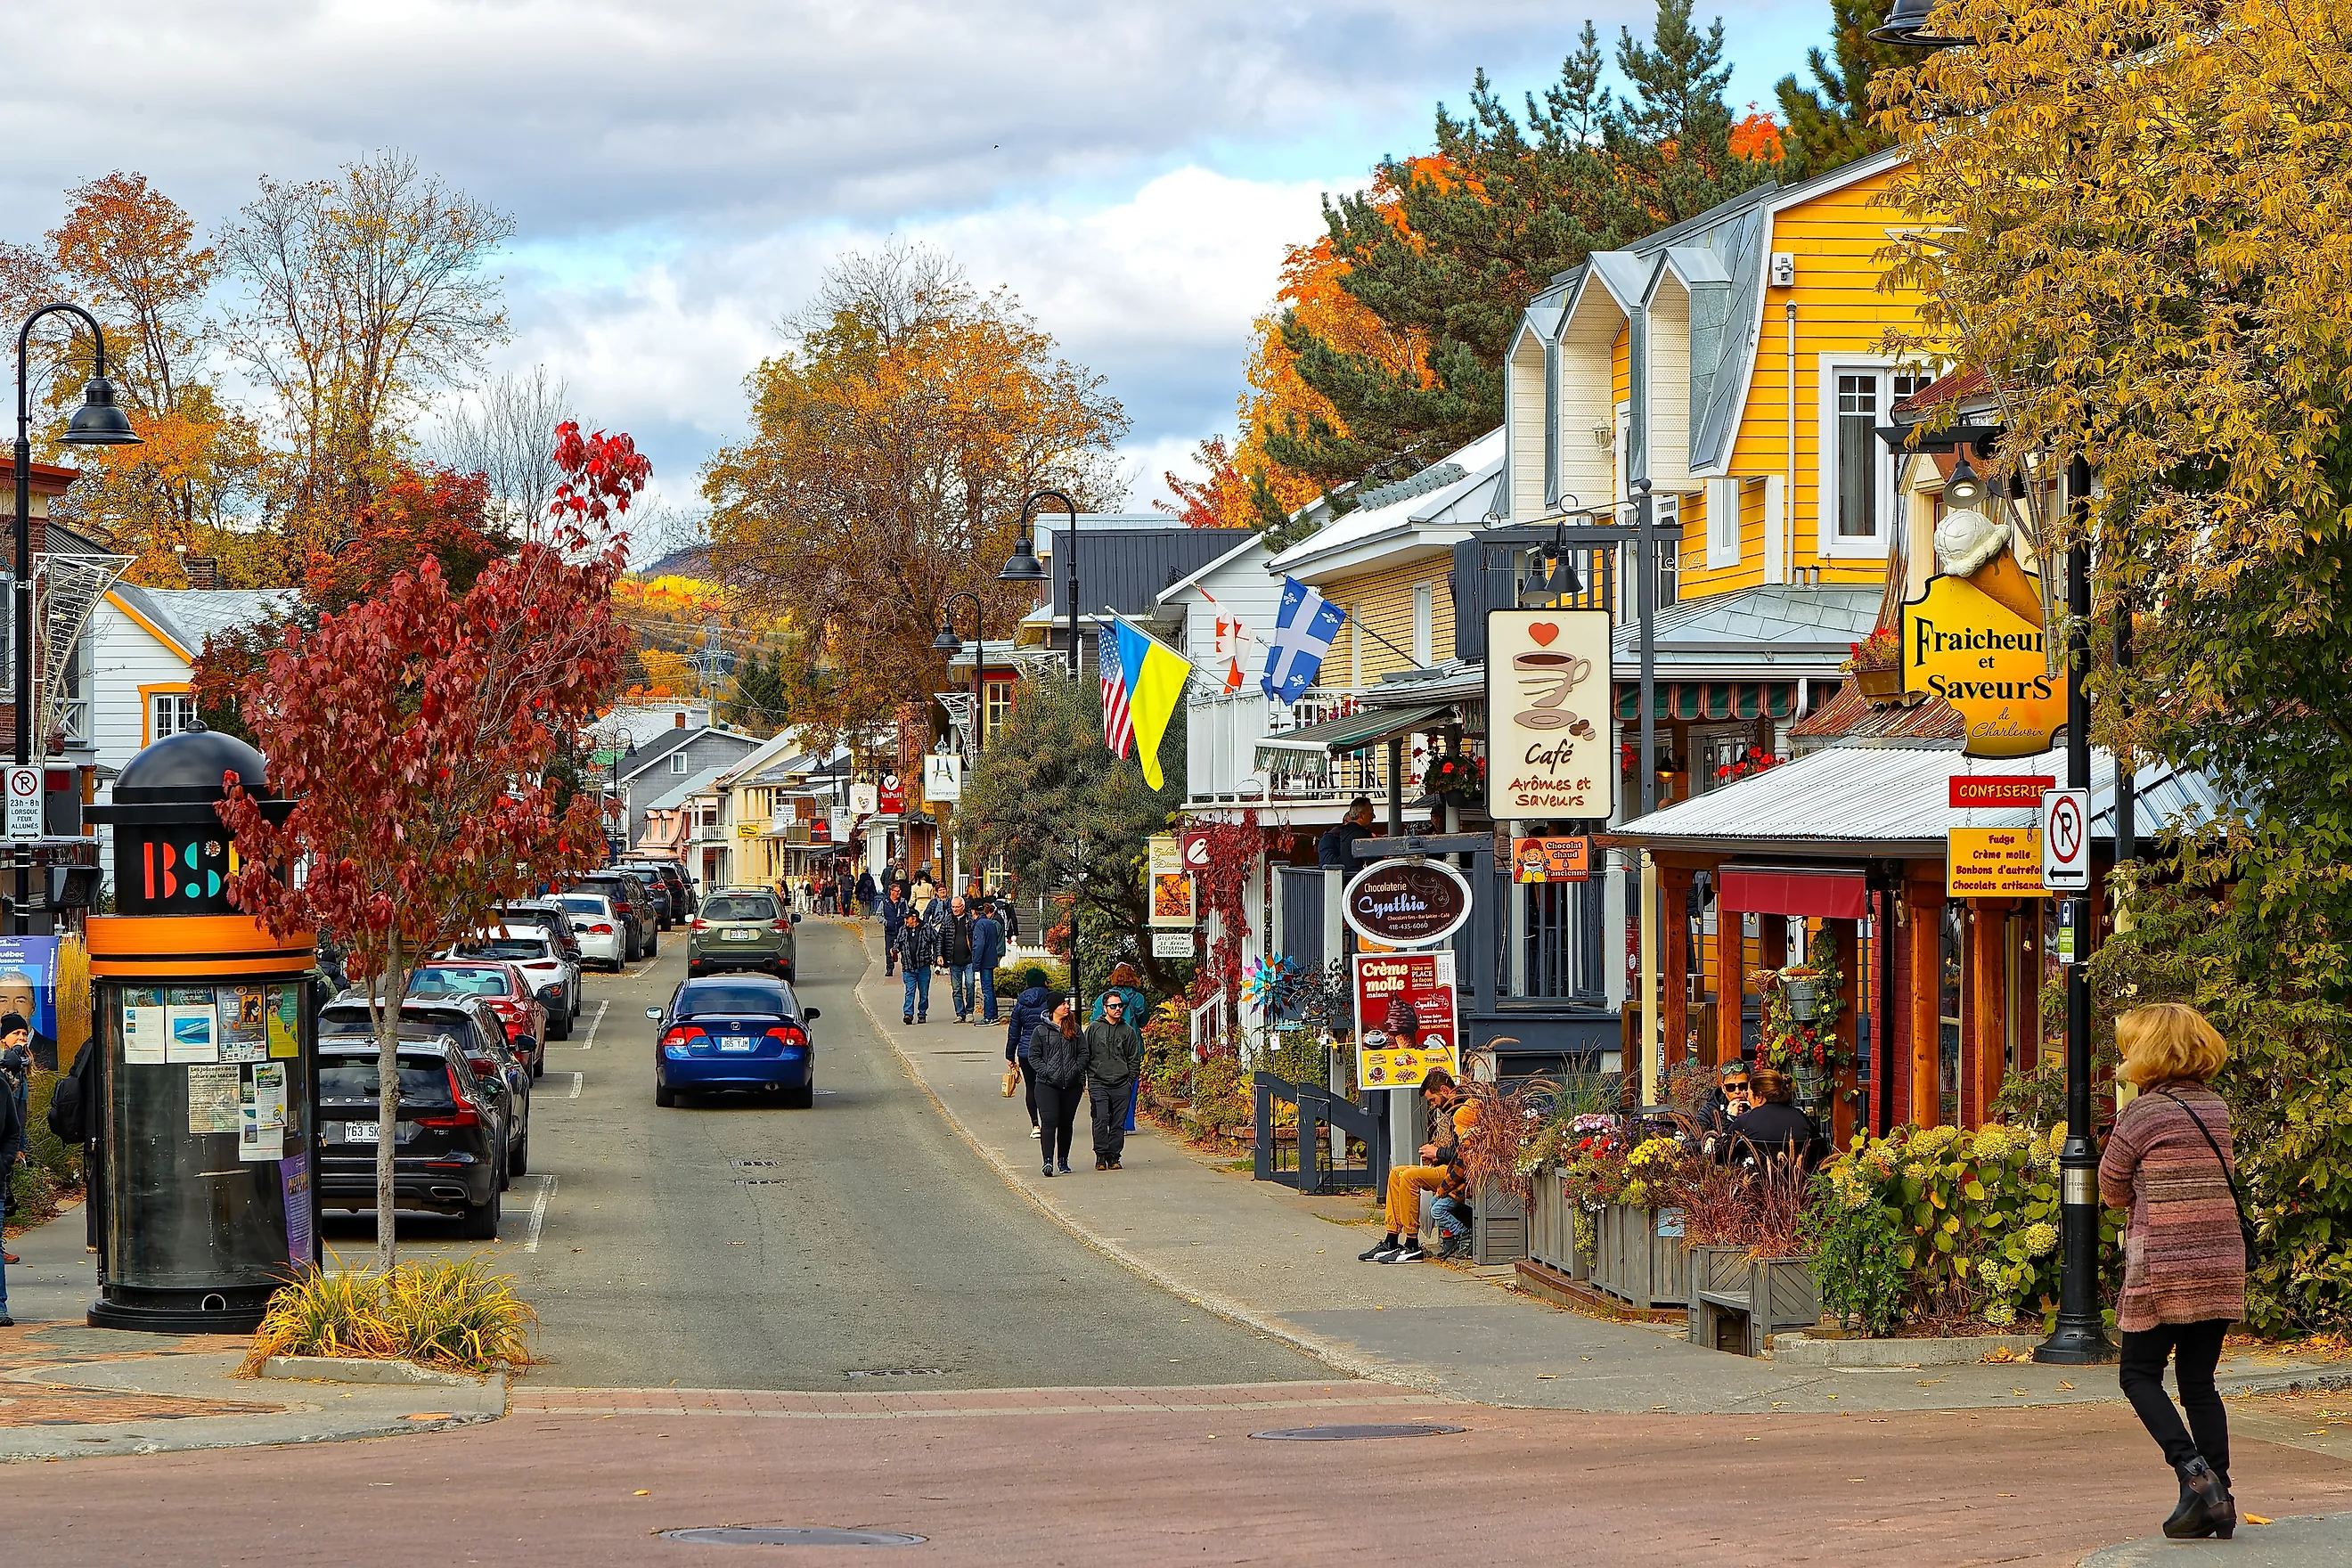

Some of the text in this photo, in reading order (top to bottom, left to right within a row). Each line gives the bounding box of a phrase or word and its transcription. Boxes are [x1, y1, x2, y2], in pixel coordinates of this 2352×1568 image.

[1978, 655, 1995, 669] et
[1997, 706, 2011, 721] de
[1972, 721, 2046, 738] Charlevoix
[1524, 738, 1574, 775] Café
[1507, 774, 1591, 791] Arômes et
[1959, 784, 2046, 798] CONFISERIE
[1515, 793, 1585, 807] Saveurs
[1546, 841, 1582, 849] Chocolat
[1988, 834, 2015, 845] Fudge
[1972, 848, 2031, 860] Crème molle
[1563, 860, 1568, 868] à
[1956, 865, 1993, 875] Bonbons
[1546, 869, 1587, 877] l'ancienne
[1364, 880, 1408, 894] Chocolaterie
[1952, 879, 1997, 890] Chocolats
[1358, 893, 1428, 919] Cynthia
[1361, 961, 1409, 977] Crème
[1365, 976, 1406, 992] molle
[722, 1040, 748, 1048] J65 YJM
[346, 1125, 363, 1137] Y63
